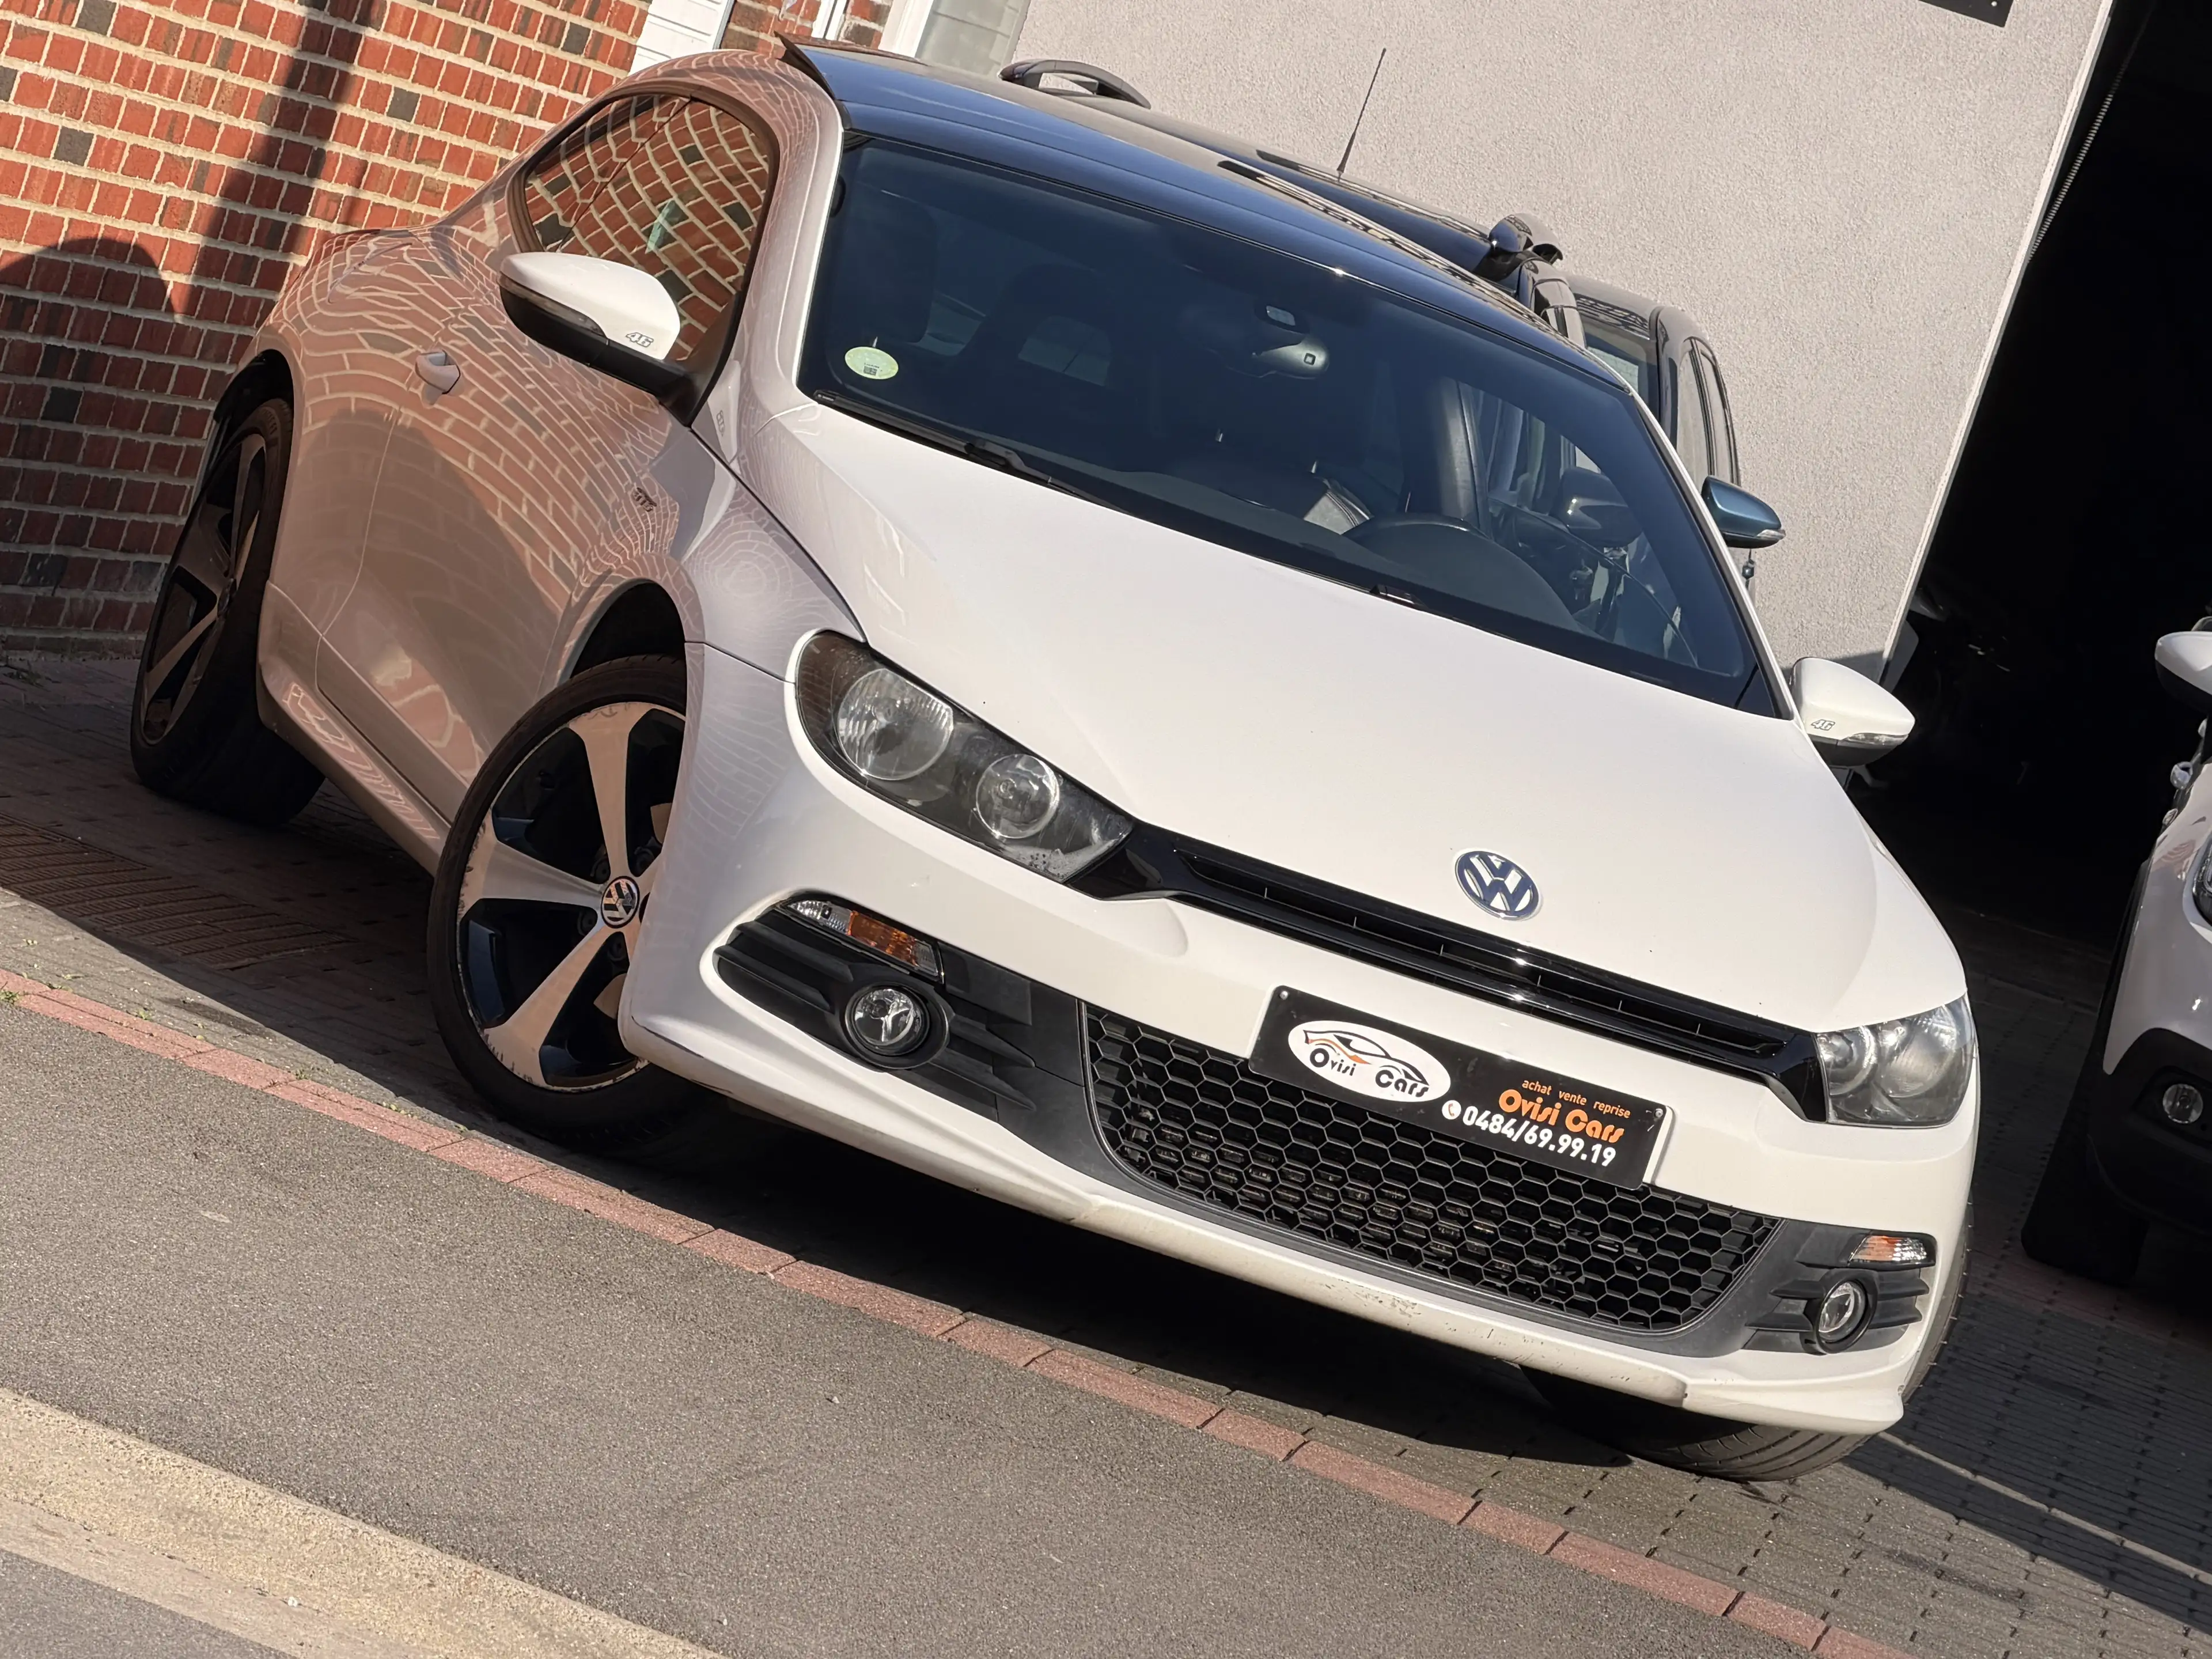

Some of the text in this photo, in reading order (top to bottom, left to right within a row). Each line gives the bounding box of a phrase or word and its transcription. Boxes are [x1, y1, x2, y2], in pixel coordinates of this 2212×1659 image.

[626, 332, 654, 347] 46
[1810, 719, 1835, 731] 46
[1455, 851, 1540, 921] VW
[1310, 1048, 1430, 1098] Ovisi Cars
[1499, 1089, 1625, 1143] Ovisi Cars
[1522, 1080, 1631, 1119] achat vente reprise
[1462, 1105, 1616, 1166] 0484/69.99.19
